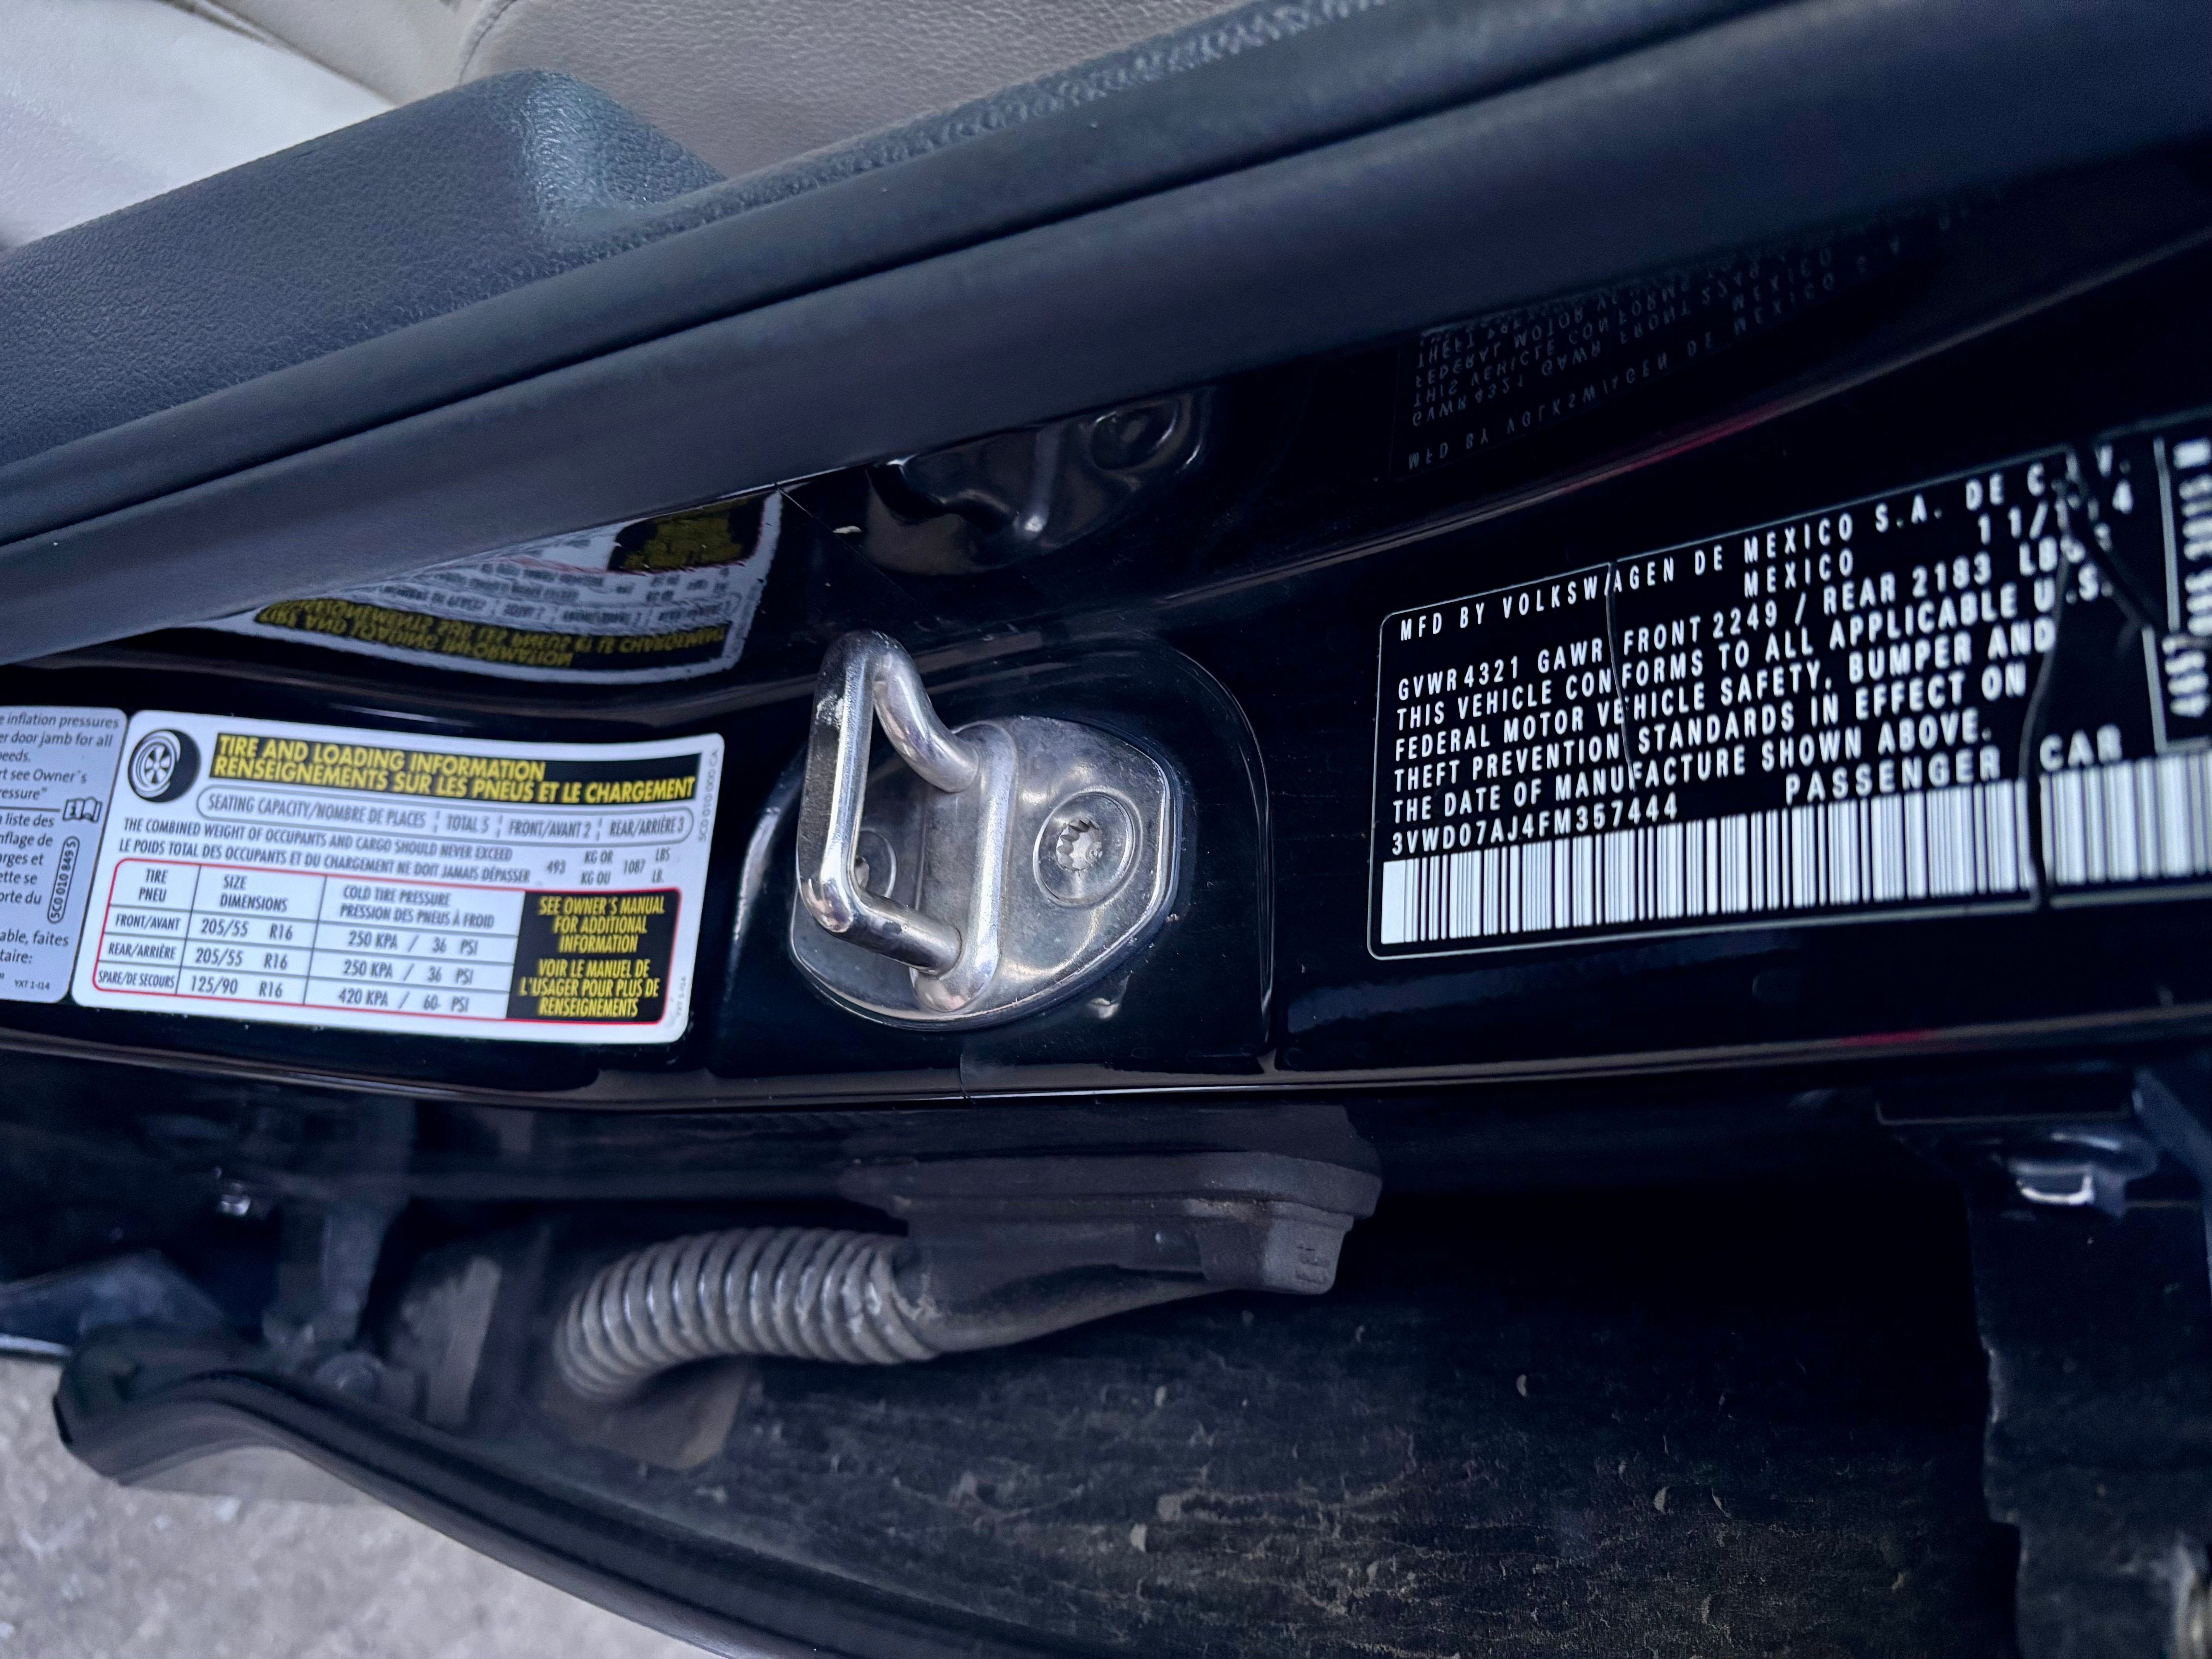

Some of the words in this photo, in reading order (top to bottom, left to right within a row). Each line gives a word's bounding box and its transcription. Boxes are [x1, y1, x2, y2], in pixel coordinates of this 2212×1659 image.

[1400, 612, 1443, 641] MFD
[1460, 602, 1485, 629] BY
[1502, 557, 1674, 619] VOLKSWAGEN
[1694, 544, 1723, 576] DE
[1744, 513, 1853, 564] MEXICO
[1875, 495, 1940, 532] S.A.
[1965, 474, 2003, 510] DE
[1744, 548, 1853, 598] MEXICO
[1398, 668, 1457, 701] GVWR
[1463, 655, 1518, 688] 4321
[1537, 637, 1603, 674] GAWR
[1623, 615, 1701, 656] FRONT
[1712, 599, 1778, 639] 2249
[1823, 573, 1896, 615] REAR
[1912, 552, 1991, 598] 2183
[1396, 701, 1445, 731] THIS
[1457, 679, 1552, 720] VEHICLE
[1565, 649, 1703, 701] CONFORMS
[1718, 639, 1750, 671] TO
[1765, 626, 1814, 663] ALL
[1829, 584, 2017, 650] APPLICABLE
[2033, 563, 2114, 613] U.S.
[1395, 723, 1491, 762] FEDERAL
[1503, 706, 1583, 744] MOTOR
[1597, 682, 1705, 728] VEHICLE
[1848, 631, 1972, 684] BUMPER
[1987, 617, 2057, 660] AND
[7, 711, 56, 726] inflation
[58, 716, 120, 729] pressures
[1394, 759, 1460, 793] THEFT
[1472, 732, 1620, 781] PREVENTION
[1638, 701, 1795, 755] STANDARDS
[1810, 693, 1839, 727] IN
[1855, 670, 1965, 720] EFFECT
[1981, 663, 2027, 701] ON
[11, 731, 38, 744] door
[38, 731, 73, 748] jamb
[76, 732, 94, 746] for
[96, 734, 114, 747] all
[219, 735, 259, 757] TIRE
[262, 738, 309, 762] AND
[313, 743, 405, 772] LOADING
[410, 752, 546, 782] INFORMATION
[11, 770, 30, 781] see
[214, 756, 389, 792] RENSEIGNEMENTS
[392, 771, 433, 795] SUR
[435, 776, 467, 798] LES
[471, 778, 534, 802] PNEUS
[538, 782, 560, 803] ET
[561, 781, 582, 804] LE
[584, 776, 696, 804] CHARGEMENT
[1393, 795, 1432, 824] THE
[1444, 784, 1501, 817] DATE
[1513, 778, 1542, 807] OF
[1555, 744, 1746, 802] MANUFACTURE
[1761, 726, 1862, 772] SHOWN
[1877, 708, 1991, 755] ABOVE.
[1391, 792, 1678, 856] 3VWD07AJ4FM357444
[1785, 746, 2000, 805] PASSENGER
[2039, 726, 2122, 772] CAR
[5, 813, 30, 826] liste
[33, 814, 54, 828] des
[208, 793, 255, 814] SEATING
[258, 797, 366, 824] CAPACITY/NOMBRE
[368, 807, 384, 824] DE
[387, 808, 427, 829] PLACES
[447, 814, 478, 833] TOTAL
[508, 818, 582, 839] FRONT/AVANT
[610, 815, 677, 838] REAR/ARRIÈRE
[37, 833, 53, 847] de
[119, 838, 131, 853] LE
[134, 839, 165, 855] POIDS
[168, 841, 198, 858] TOTAL
[202, 844, 222, 859] DES
[225, 846, 287, 866] OCCUPANTS
[289, 851, 302, 865] ET
[323, 854, 395, 874] CHARGEMENT
[124, 817, 144, 832] THE
[146, 819, 201, 836] COMBINED
[204, 823, 246, 840] WEIGHT
[248, 826, 263, 842] OF
[266, 828, 326, 847] OCCUPANTS
[329, 834, 353, 850] AND
[356, 836, 392, 852] CARGO
[546, 859, 567, 875] 493
[623, 859, 646, 874] 1087
[24, 874, 38, 885] se
[61, 850, 74, 871] 849
[25, 892, 42, 905] du
[56, 873, 69, 895] 010
[146, 868, 168, 884] TIRE
[222, 874, 248, 890] SIZE
[342, 884, 371, 901] COLD
[374, 887, 397, 903] TIRE
[398, 888, 452, 908] PRESSURE
[138, 886, 167, 903] PNEU
[219, 892, 289, 913] DIMENSIONS
[339, 902, 392, 921] PRESSION
[393, 906, 414, 923] DES
[416, 908, 451, 927] PNEUS
[464, 912, 495, 929] FROID
[538, 895, 562, 915] SEE
[563, 896, 618, 916] OWNER'S
[619, 895, 665, 915] MANUAL
[33, 931, 69, 947] faites
[115, 913, 181, 931] FRONT/AVANT
[200, 917, 249, 938] 205/55
[269, 922, 293, 941] R16
[347, 929, 372, 948] 250
[374, 931, 398, 950] KPA
[431, 936, 447, 954] 36
[459, 938, 479, 956] PSI
[553, 915, 579, 934] FOR
[580, 915, 648, 935] ADDITIONAL
[558, 934, 639, 953] INFORMATION
[108, 941, 177, 960] REAR/ARRIÈRE
[195, 947, 244, 967] 205/55
[263, 952, 289, 970] R16
[342, 958, 367, 977] 250
[369, 961, 393, 980] KPA
[426, 965, 443, 982] 36
[454, 967, 474, 986] PSI
[537, 958, 568, 977] VOIR
[569, 959, 585, 978] LE
[585, 959, 633, 978] MANUEL
[634, 958, 651, 978] DE
[98, 969, 139, 986] SPARE/DE
[139, 973, 175, 988] SECOURS
[191, 974, 239, 995] 125/90
[258, 980, 283, 998] R16
[338, 987, 363, 1006] 420
[365, 989, 388, 1007] KPA
[450, 996, 470, 1013] PSI
[519, 976, 579, 997] L'USAGER
[581, 978, 614, 998] POUR
[615, 978, 643, 998] PLUS
[644, 977, 661, 998] DE
[538, 996, 639, 1018] RENSEIGNEMENTS
